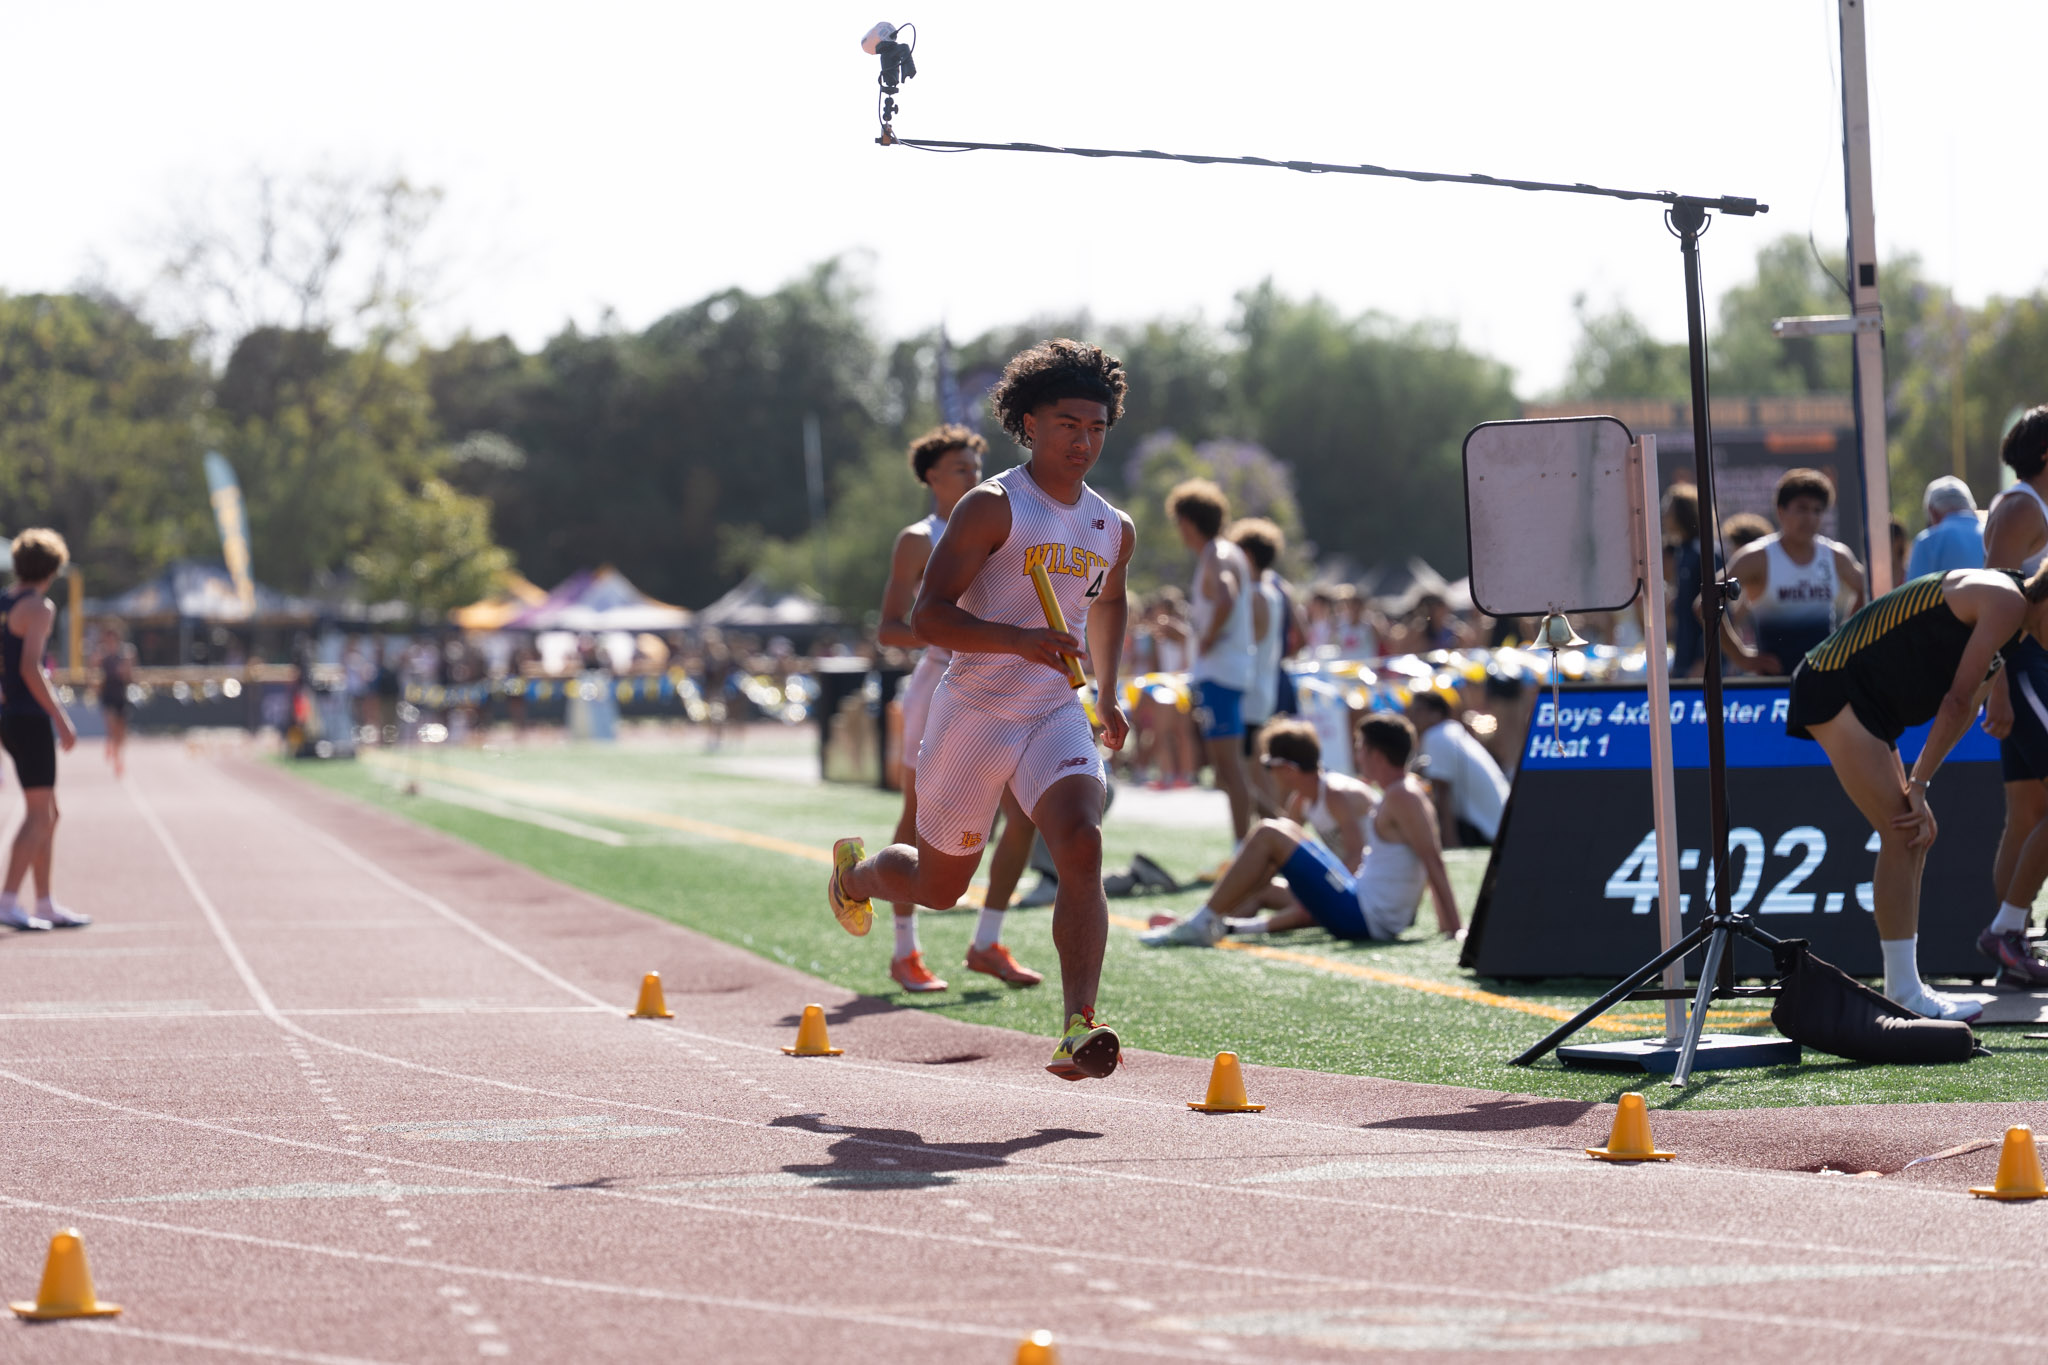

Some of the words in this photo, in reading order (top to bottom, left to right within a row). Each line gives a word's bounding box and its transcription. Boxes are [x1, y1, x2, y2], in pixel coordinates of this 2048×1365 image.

[1085, 570, 1104, 599] 4
[1536, 703, 1603, 732] Boys
[1607, 701, 1685, 726] 4x80
[1529, 735, 1591, 758] Heat
[1597, 734, 1610, 757] 1
